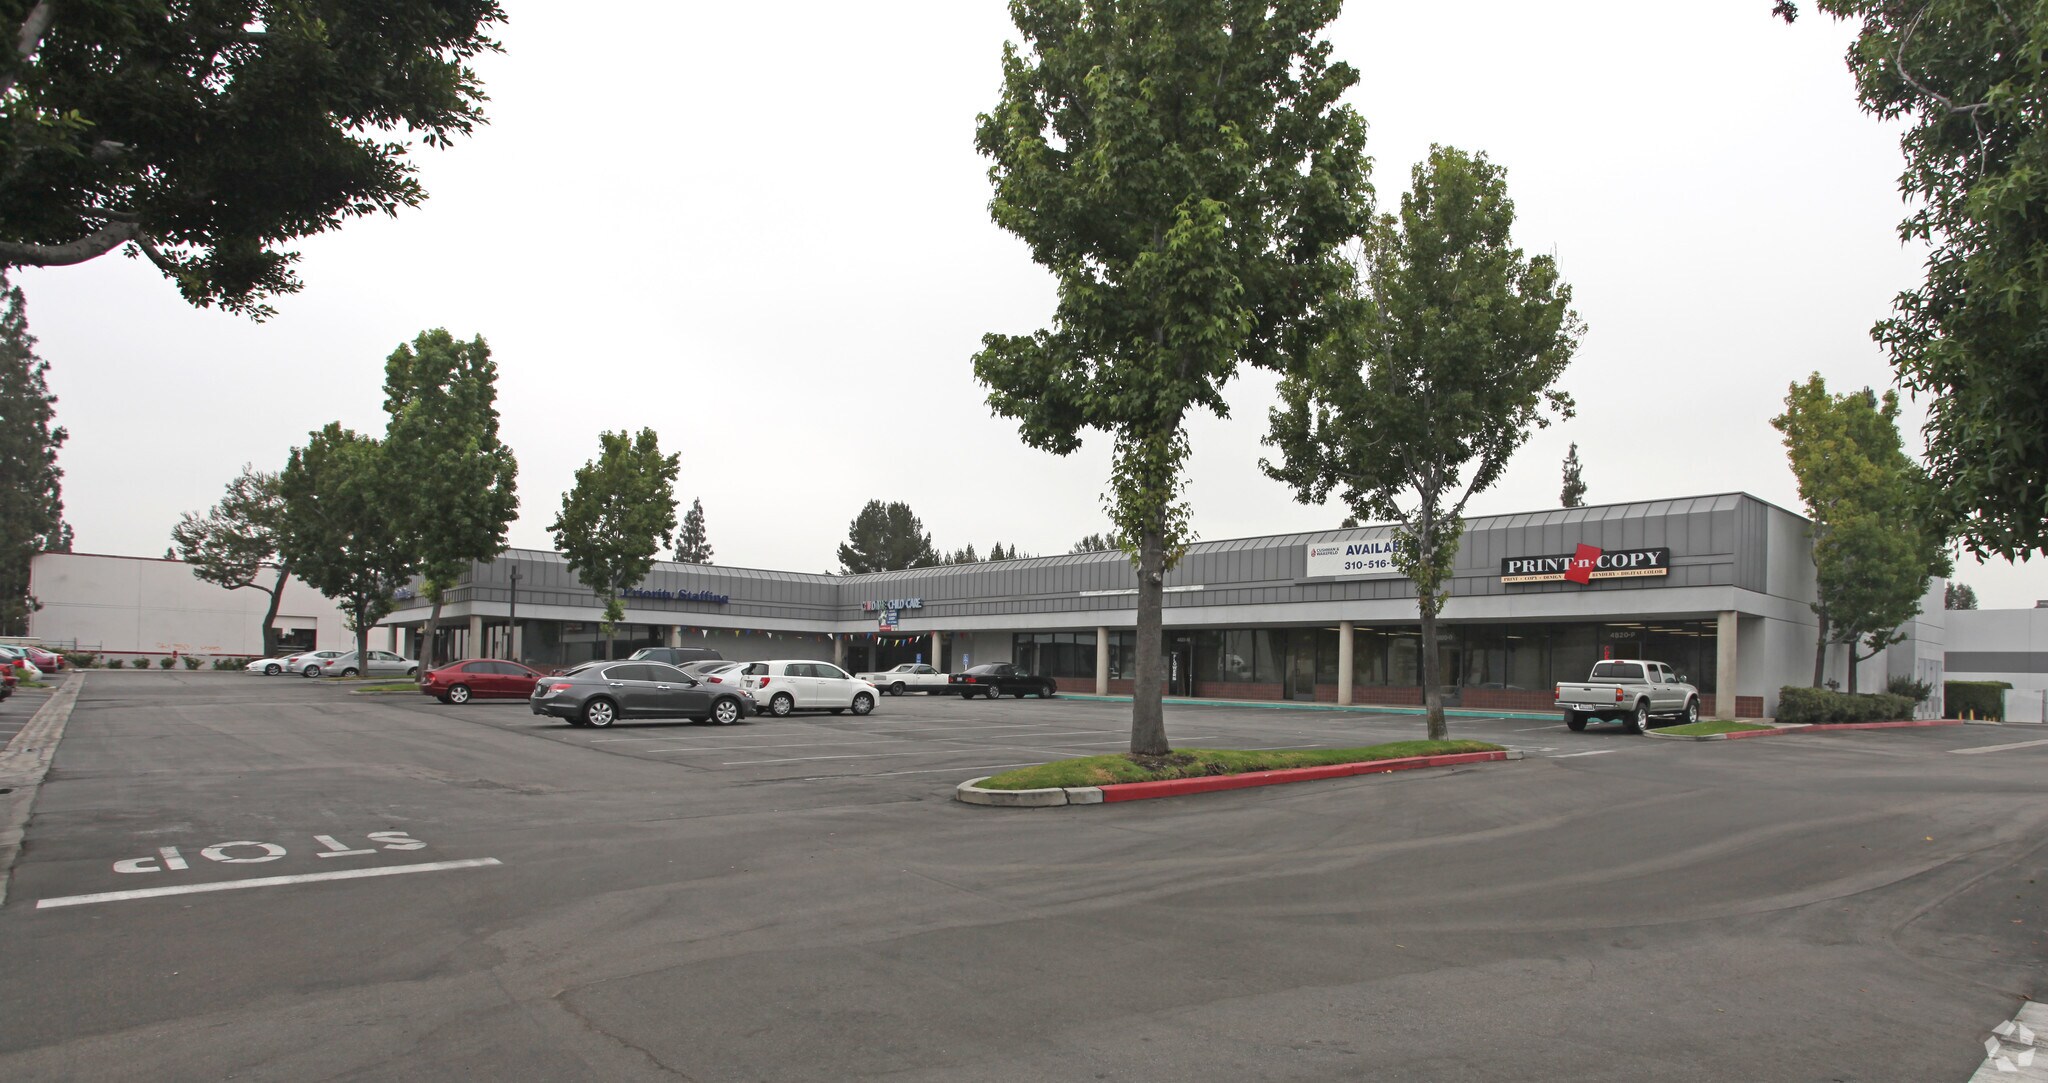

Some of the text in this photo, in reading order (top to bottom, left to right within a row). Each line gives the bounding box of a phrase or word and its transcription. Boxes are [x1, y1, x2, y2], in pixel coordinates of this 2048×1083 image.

[1508, 557, 1574, 574] PRINT
[1596, 551, 1661, 568] COPY
[678, 590, 729, 604] Staffing
[888, 599, 904, 609] CHILD
[906, 598, 922, 608] CARE
[113, 831, 427, 873] STOP
